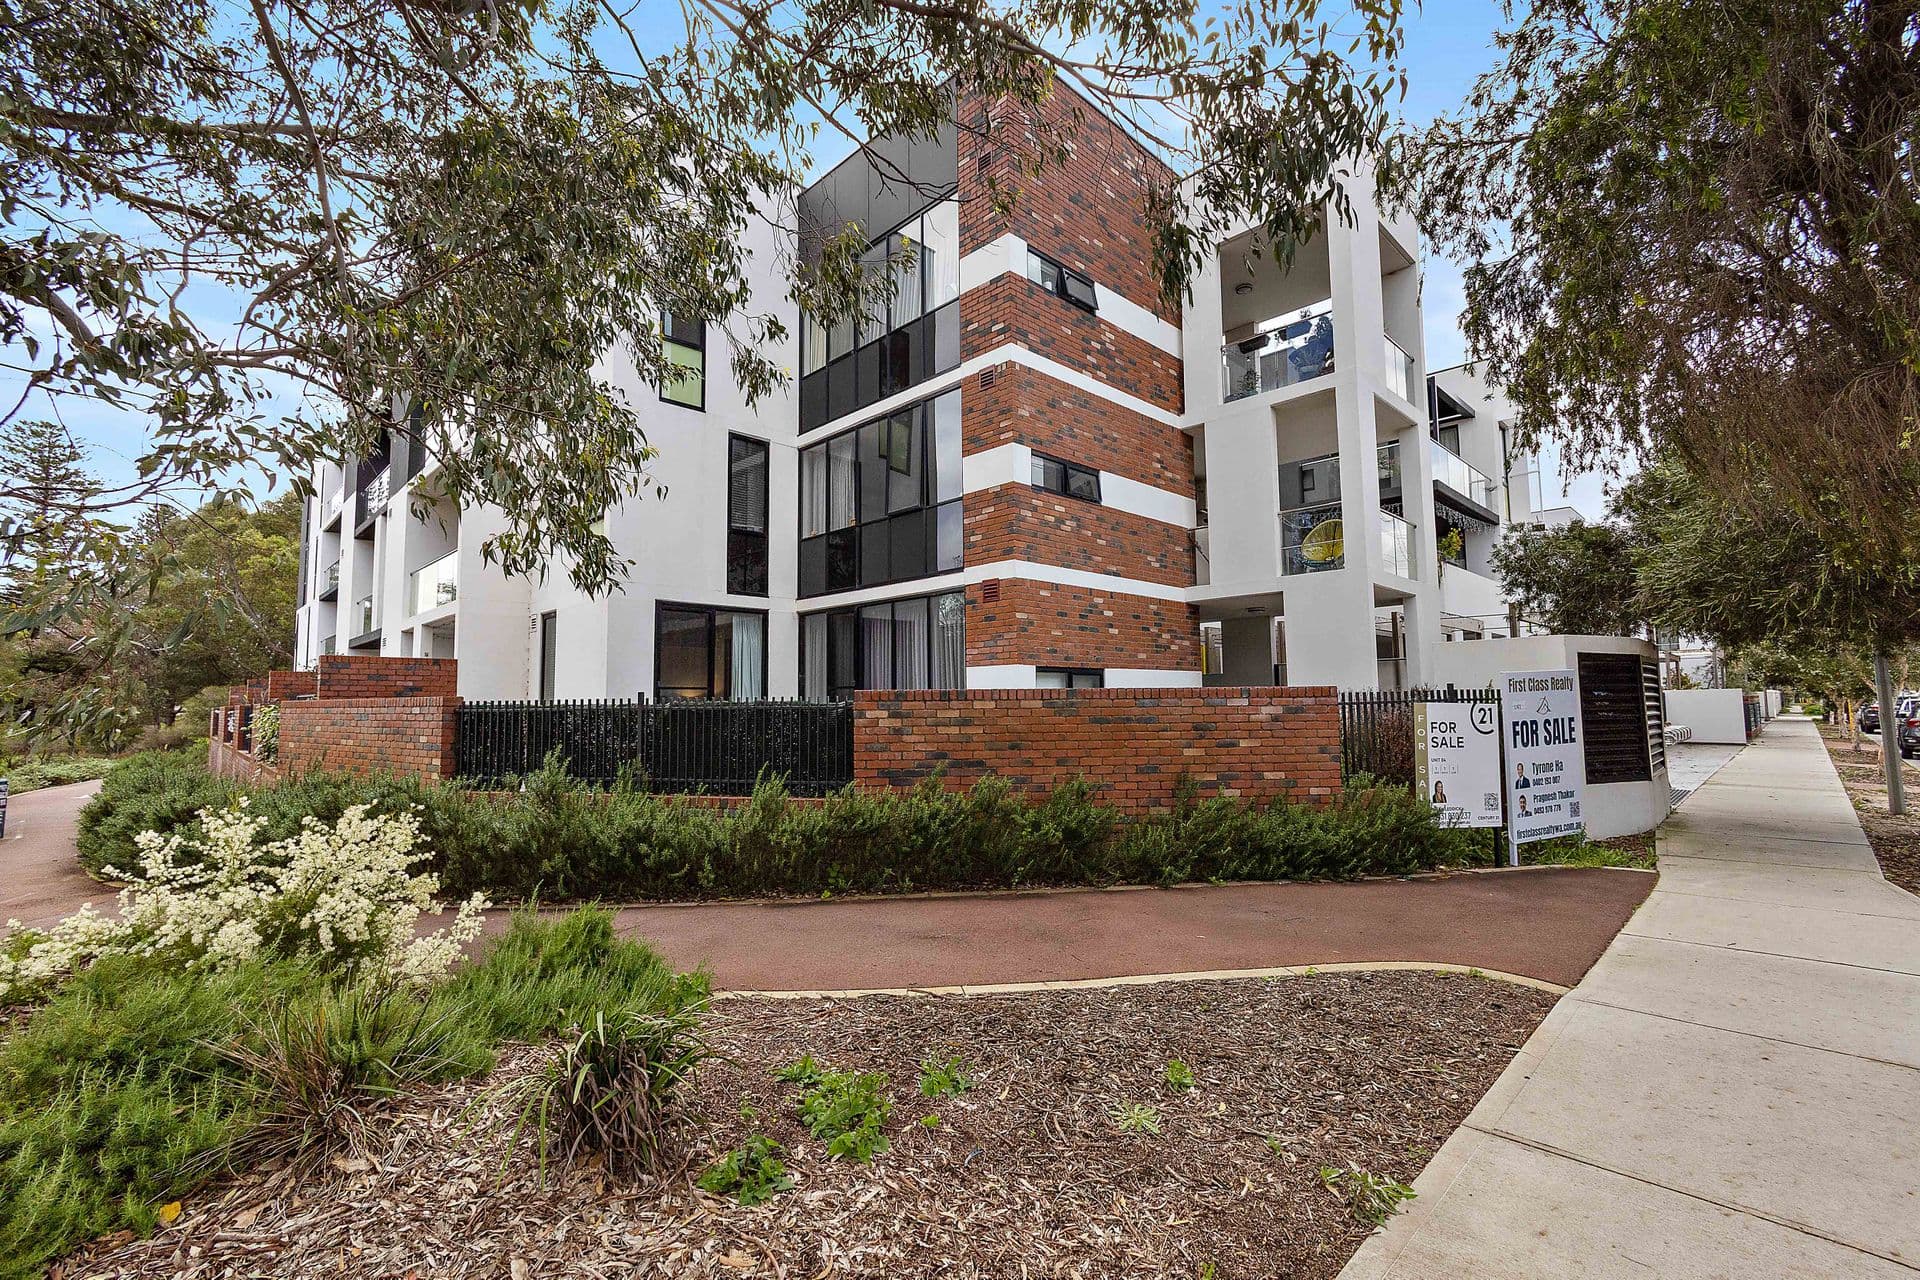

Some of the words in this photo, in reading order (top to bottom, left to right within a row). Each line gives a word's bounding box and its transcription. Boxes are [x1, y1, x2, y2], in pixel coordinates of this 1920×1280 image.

[1508, 678, 1526, 693] First
[1528, 677, 1549, 692] Class
[1551, 676, 1573, 691] Realty
[1478, 707, 1493, 724] 21
[1430, 722, 1456, 733] FOR
[1512, 719, 1539, 748] FOR
[1543, 717, 1576, 745] SALE
[1431, 737, 1464, 748] SALE
[1532, 762, 1554, 775] Tyrone
